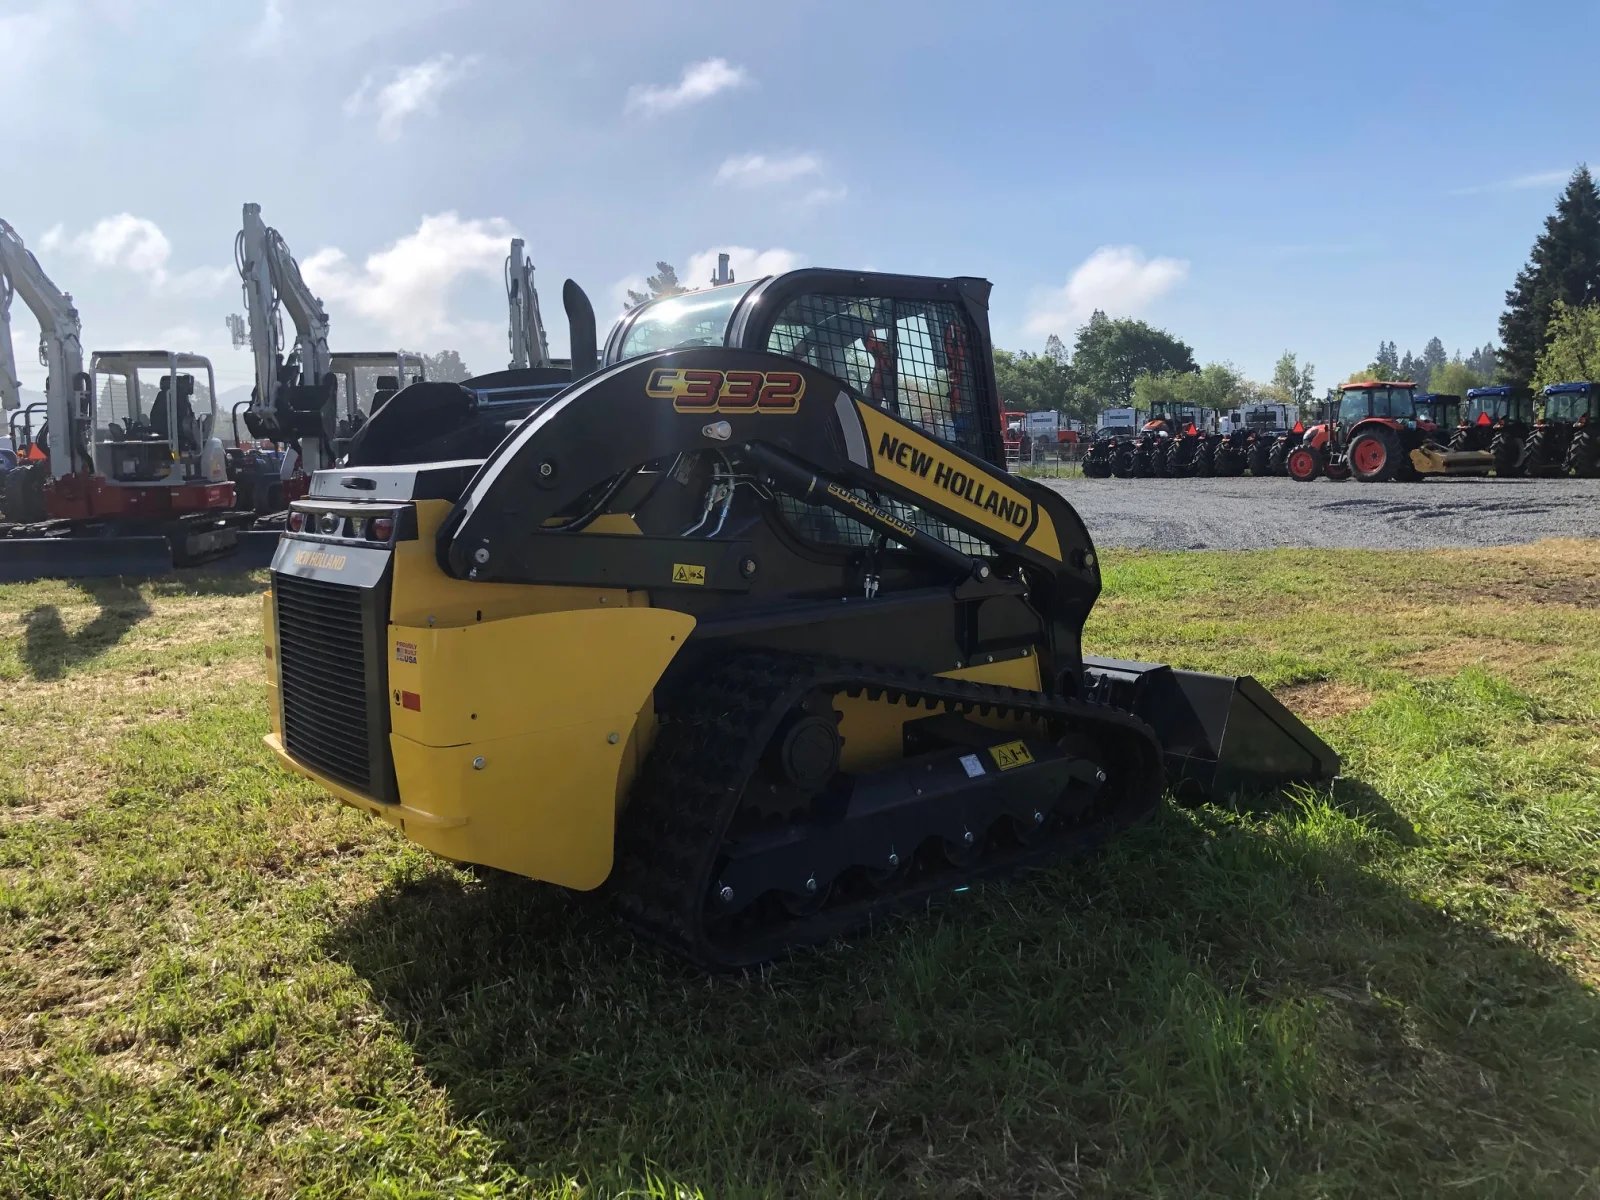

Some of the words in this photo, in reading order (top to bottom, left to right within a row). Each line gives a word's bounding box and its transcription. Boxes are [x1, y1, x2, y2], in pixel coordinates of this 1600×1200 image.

[647, 369, 805, 412] C332
[878, 432, 933, 478] NEW
[933, 461, 1028, 529] HOLLAND
[875, 508, 916, 537] BOOM
[309, 552, 347, 571] HOLLAND
[396, 640, 418, 650] PROUDLY
[404, 655, 417, 664] USA
